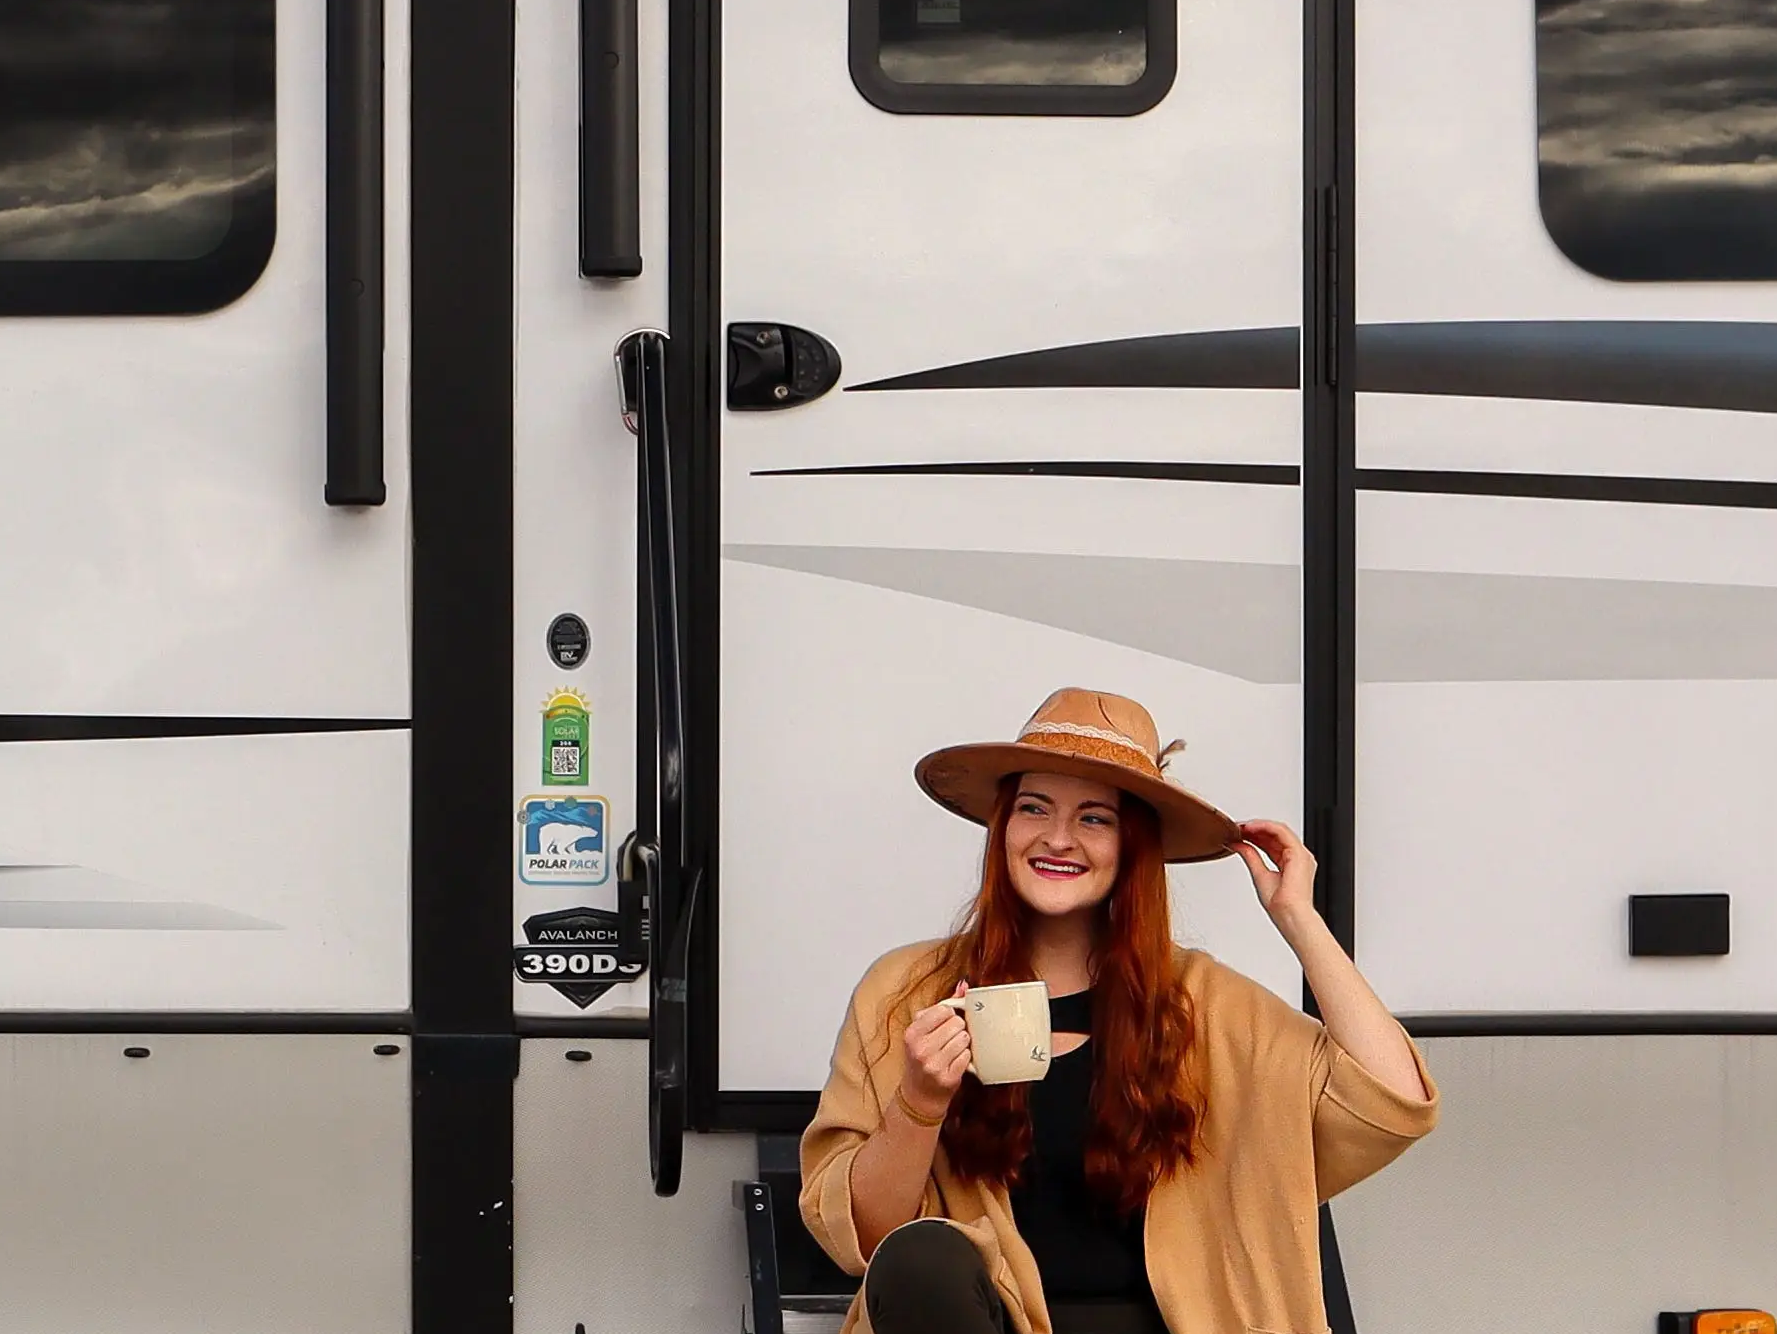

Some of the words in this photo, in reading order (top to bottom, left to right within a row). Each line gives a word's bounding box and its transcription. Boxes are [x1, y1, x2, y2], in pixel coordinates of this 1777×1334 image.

[529, 859, 567, 869] POLAR
[569, 859, 600, 869] PACK
[538, 930, 619, 940] AVALANCH
